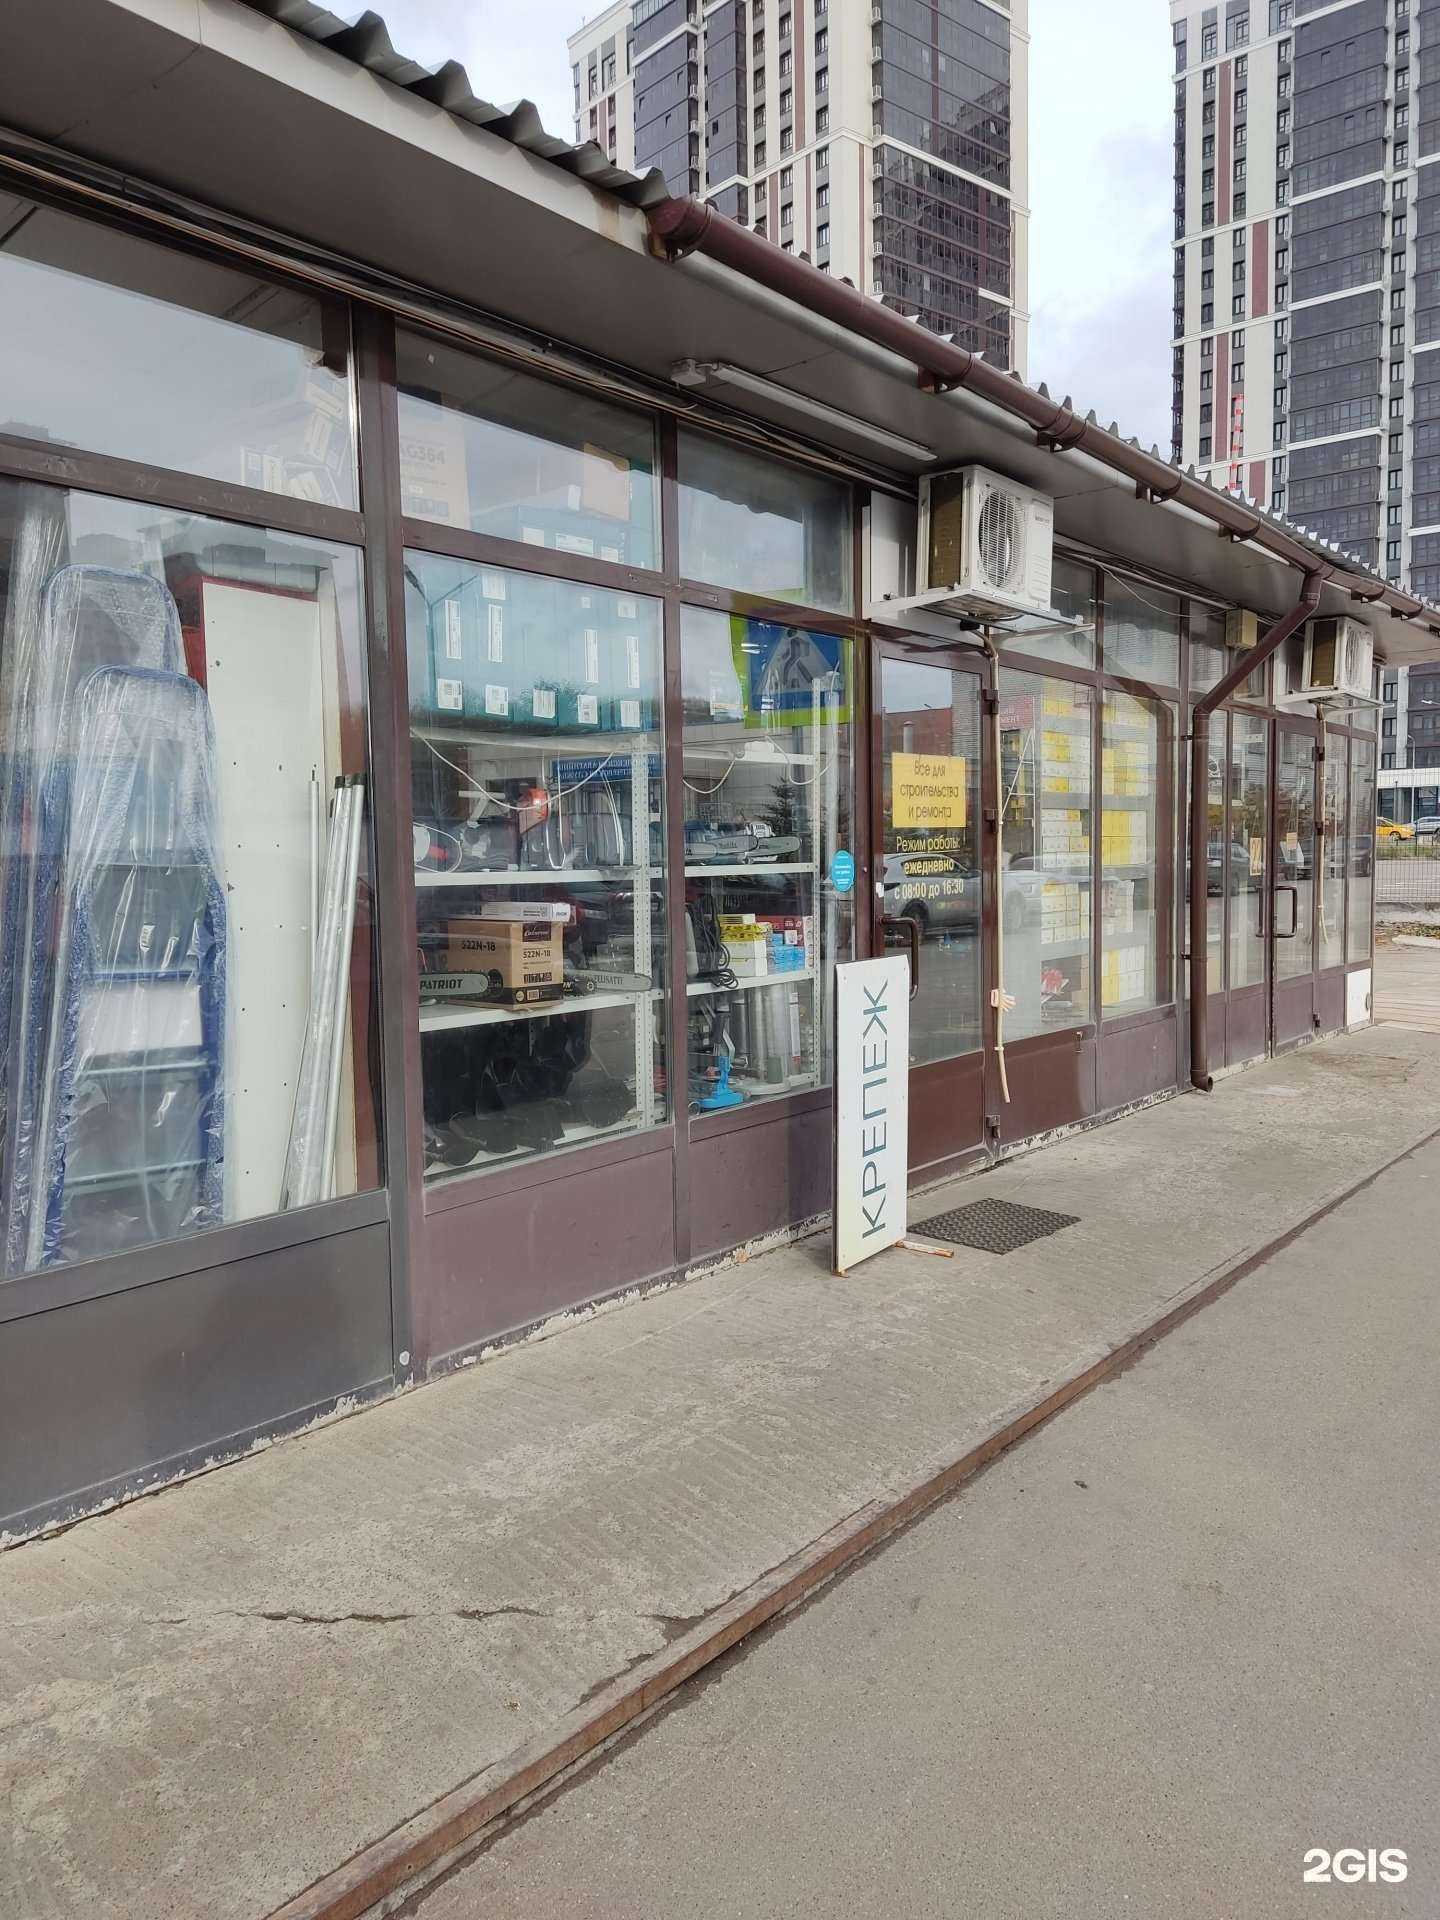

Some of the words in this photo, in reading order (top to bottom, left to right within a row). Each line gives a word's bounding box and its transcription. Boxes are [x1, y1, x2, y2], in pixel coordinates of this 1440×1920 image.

[914, 760, 930, 776] Все
[932, 764, 946, 778] для
[900, 784, 959, 800] строительства
[908, 806, 914, 818] и
[915, 806, 952, 821] ремонта
[896, 836, 926, 853] Режим
[904, 859, 954, 875] ежедневно
[894, 886, 900, 900] с
[902, 882, 926, 899] 08:00
[928, 883, 940, 899] до
[943, 879, 964, 895] 16:30
[419, 978, 463, 990] PATRIOT
[862, 978, 888, 1239] КРЕПЕЖ
